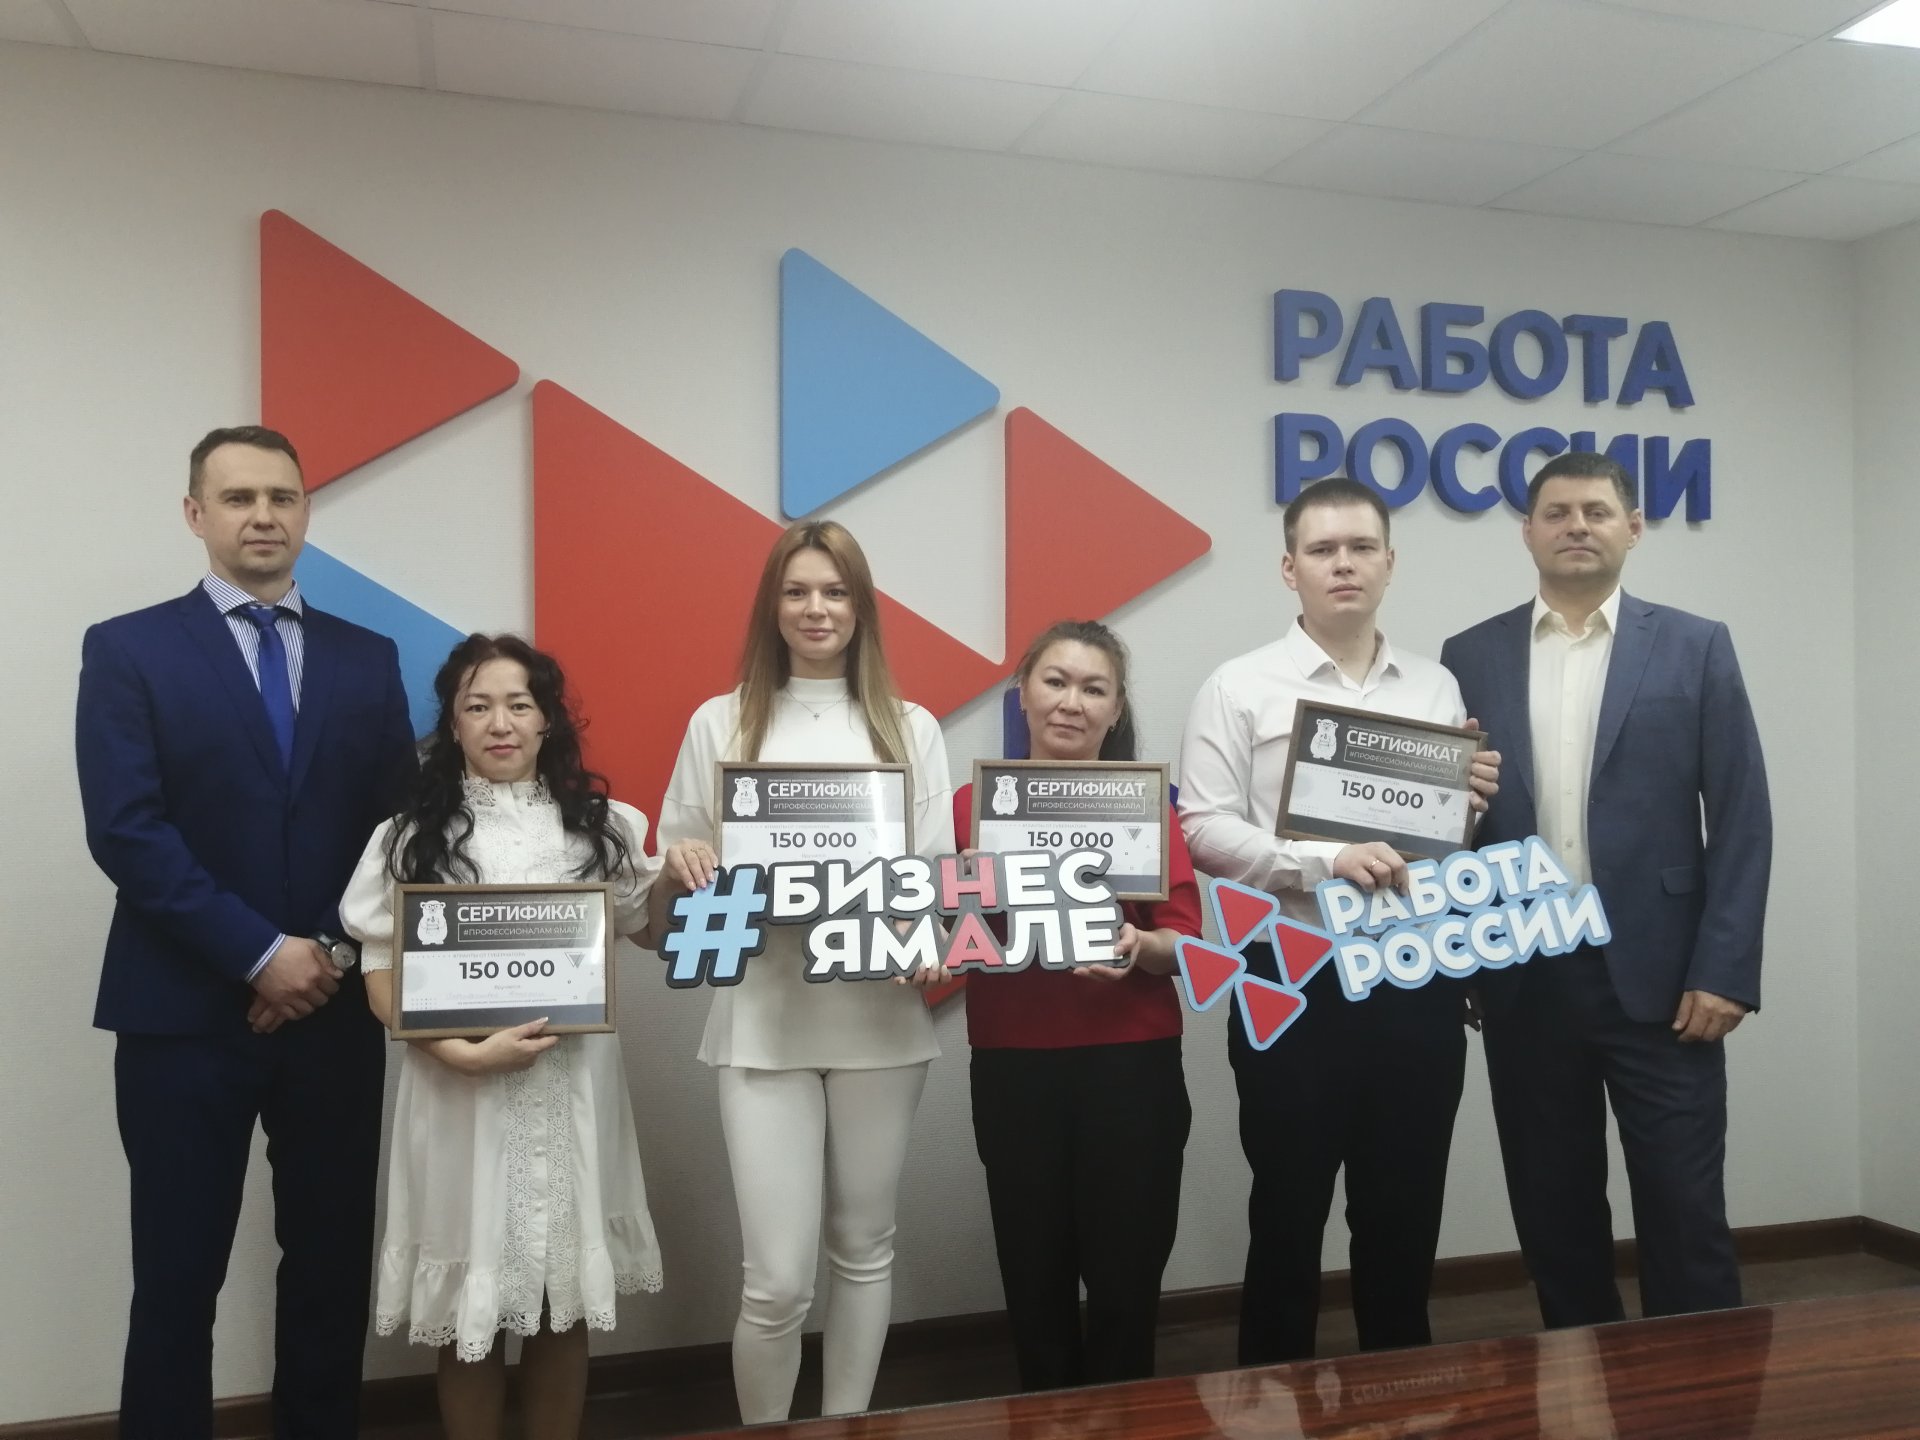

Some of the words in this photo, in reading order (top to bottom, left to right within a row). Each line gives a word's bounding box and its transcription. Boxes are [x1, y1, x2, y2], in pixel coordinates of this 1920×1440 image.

[1274, 288, 1696, 409] РАБОТА
[1346, 730, 1463, 762] СЕРТИФИКАТ
[1027, 781, 1146, 797] СЕРТИФИКАТ
[1341, 779, 1375, 800] 150
[1381, 788, 1424, 809] 000
[1032, 801, 1112, 810] #ПРОФЕССИОНАЛАМ
[1113, 802, 1141, 810] ЯМАЛА
[769, 832, 806, 848] 150
[813, 832, 857, 848] 000
[1027, 831, 1063, 848] 150
[1070, 832, 1114, 848] 000
[1324, 840, 1568, 935] РАБОТА
[457, 904, 588, 922] СЕРТИФИКАТ
[463, 927, 552, 937] #ПРОФЕССИОНАЛАМ
[553, 925, 584, 935] ЯМАЛА
[808, 907, 1124, 975] ЯМАЛЕ
[1338, 890, 1606, 995] РОССИИ
[459, 960, 499, 979] 150
[507, 959, 555, 978] 000
